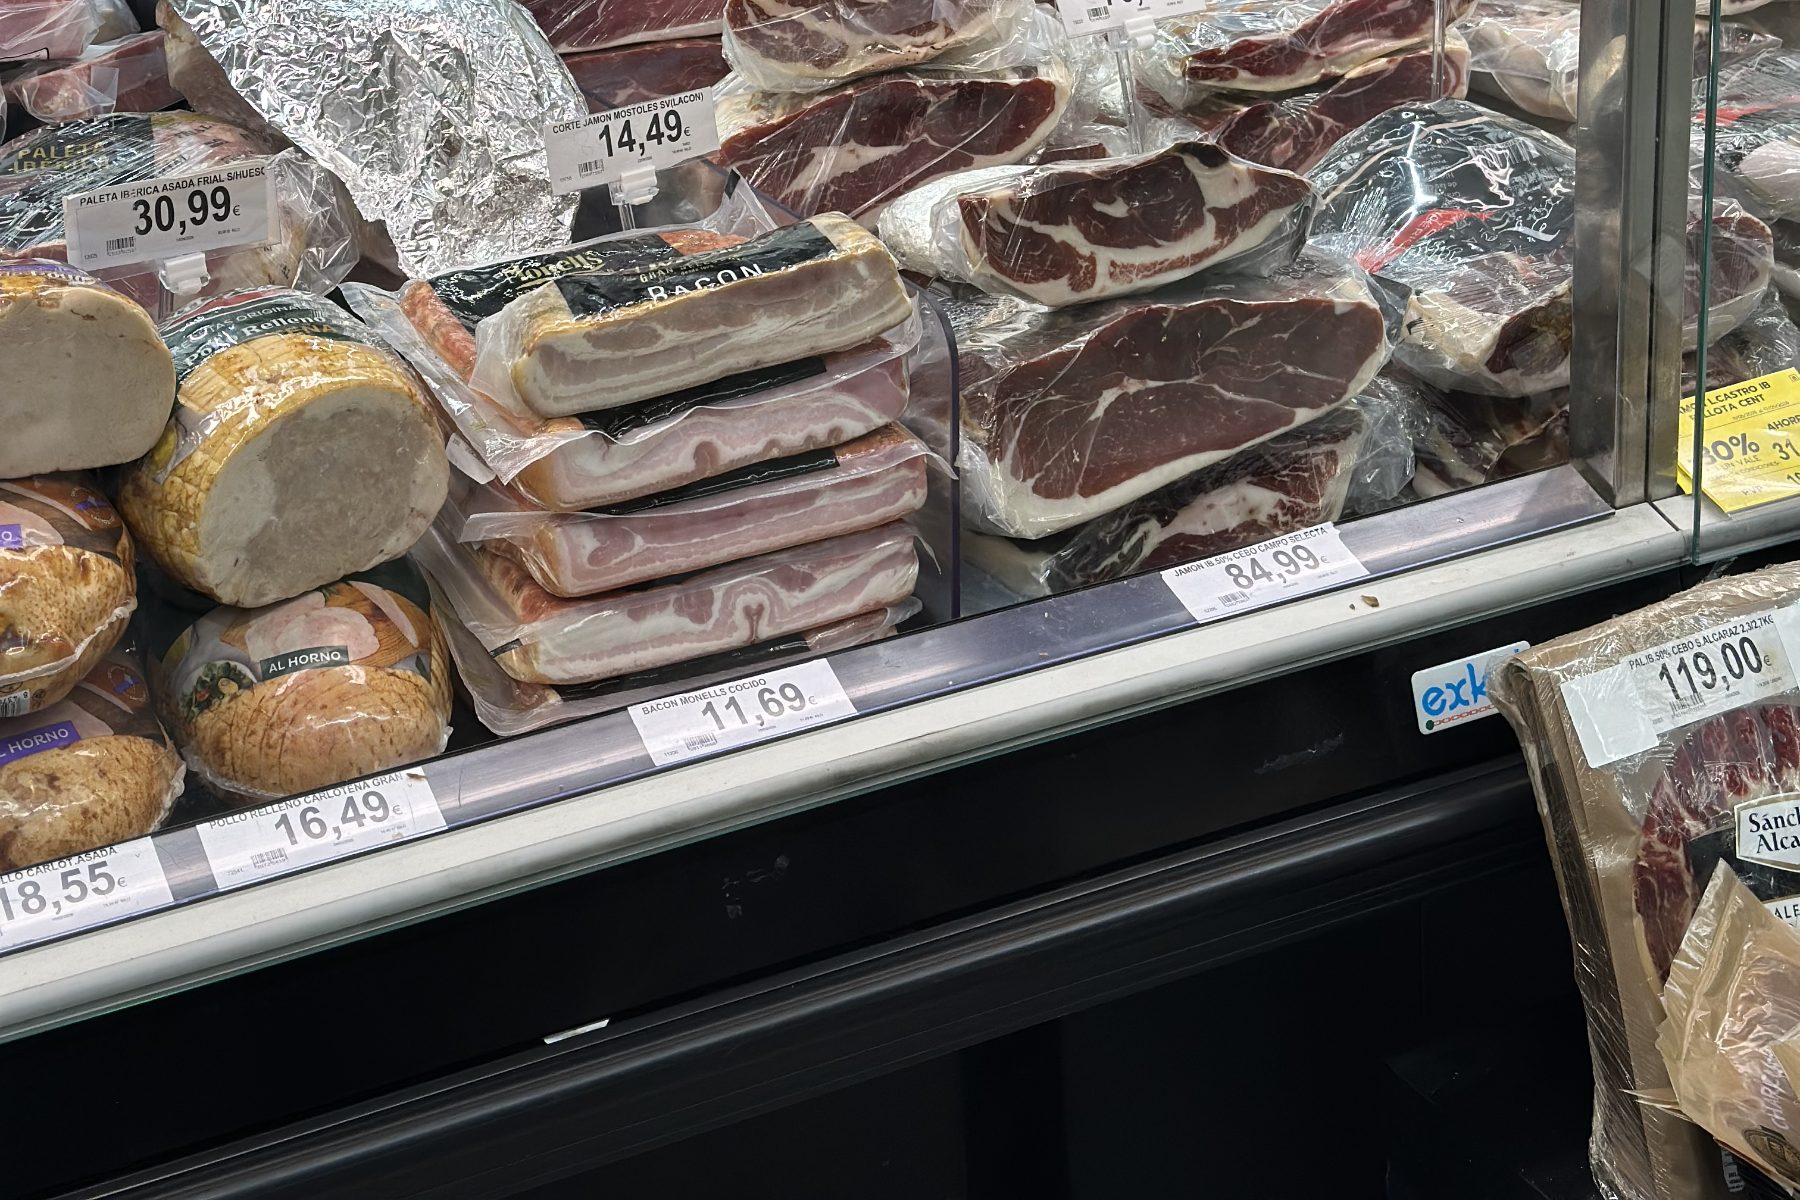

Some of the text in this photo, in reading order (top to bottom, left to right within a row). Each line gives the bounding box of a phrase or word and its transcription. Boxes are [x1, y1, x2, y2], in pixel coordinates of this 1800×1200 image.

[553, 92, 704, 134] CORTE JAMON MOSTOLES SV(LACON)
[80, 193, 118, 206] PALETA
[120, 186, 159, 199] IBERICA
[161, 180, 195, 193] ASADA
[197, 176, 224, 187] FRIAL
[241, 315, 327, 338] Relleno
[1738, 394, 1766, 407] CENT
[1758, 381, 1771, 390] IB
[1174, 527, 1328, 577] JAMON IB.50% CEBO CAMPO SELECTA
[1671, 641, 1695, 655] CEBO
[1695, 625, 1740, 647] S.ALCARAZ
[268, 650, 341, 673] AL HORNO
[642, 677, 767, 715] BACON MONELLS COCIDO
[8, 729, 69, 753] HORNO
[209, 772, 403, 829] POLLO RELLENO CARLOTENA GRAN
[26, 846, 117, 877] CARLOT.ASADA
